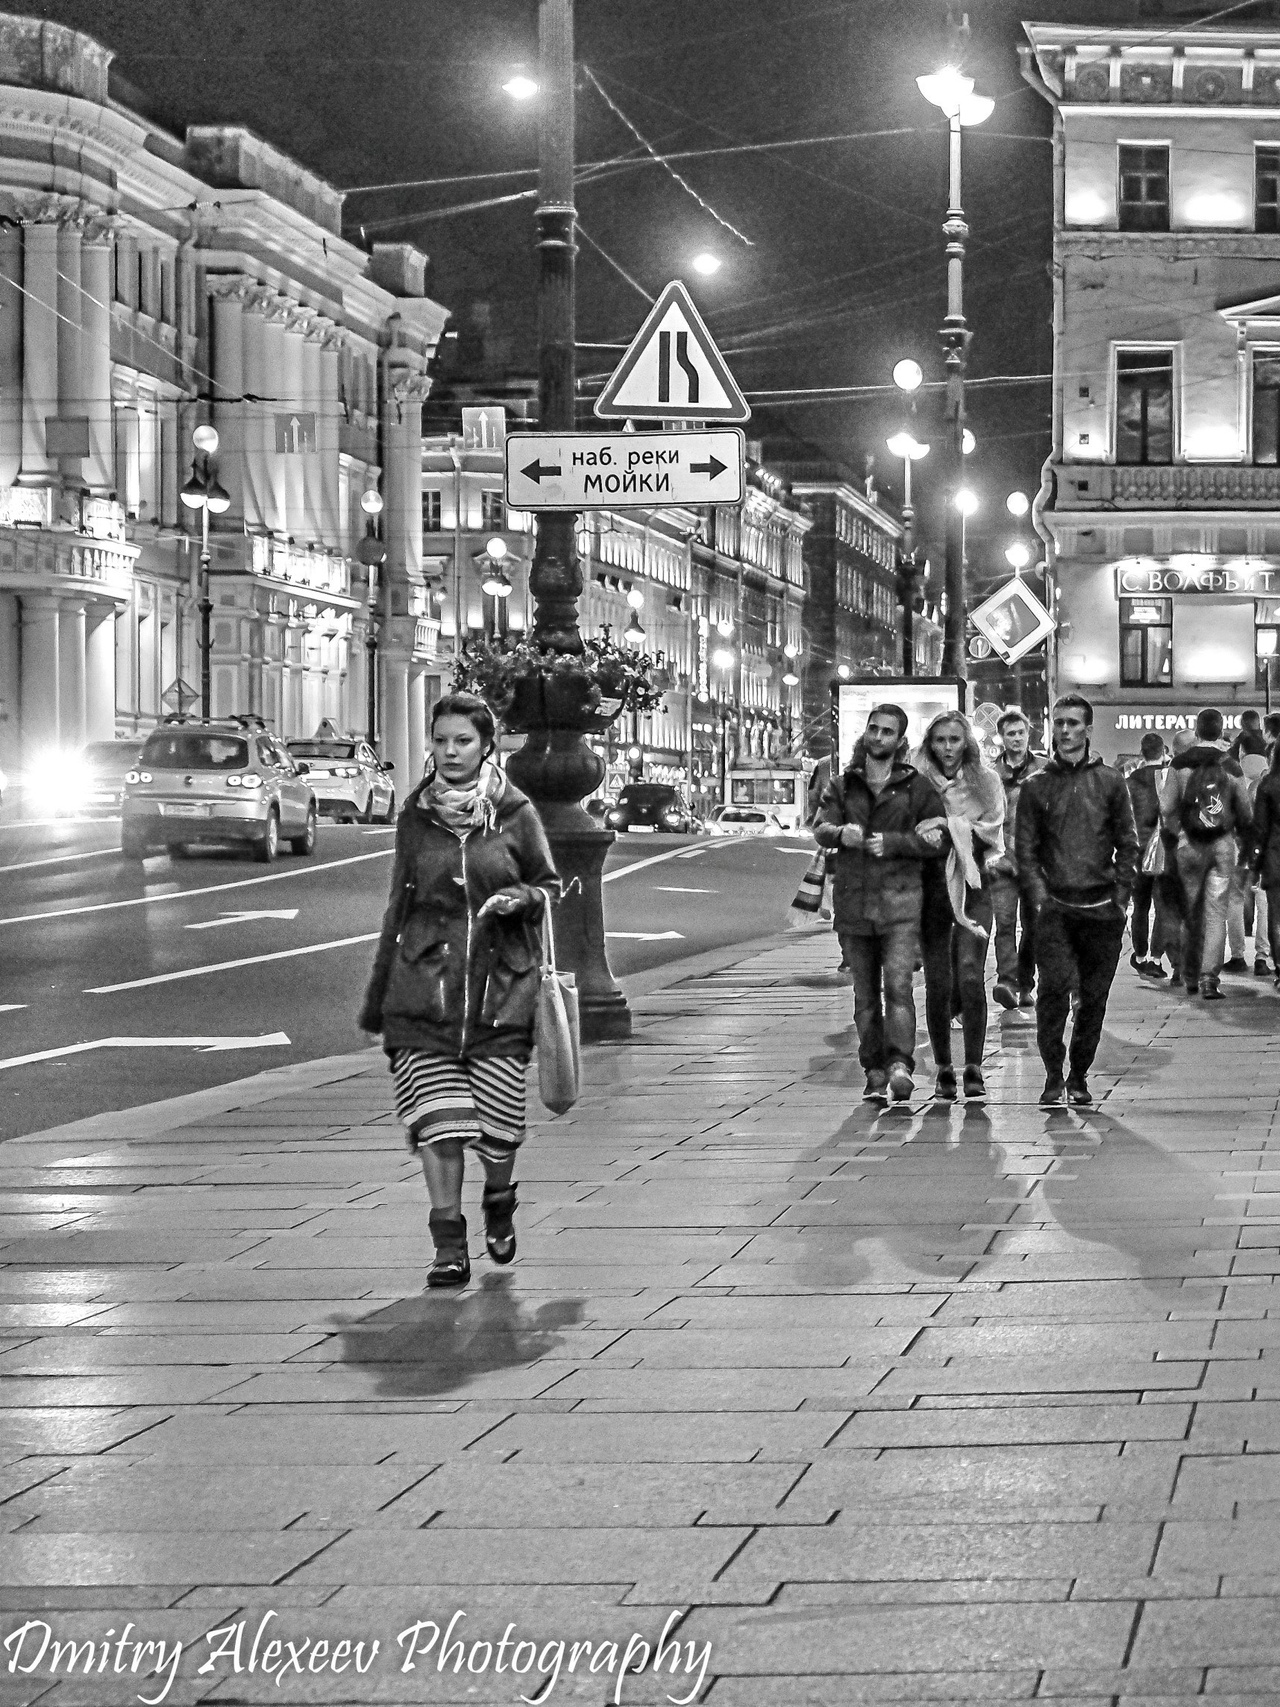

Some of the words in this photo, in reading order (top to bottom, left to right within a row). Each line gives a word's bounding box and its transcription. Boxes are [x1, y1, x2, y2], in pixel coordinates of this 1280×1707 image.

[572, 446, 617, 466] наб.
[628, 449, 679, 470] реки
[583, 469, 670, 493] МОЙКИ
[1121, 571, 1142, 592] С.
[1147, 571, 1240, 592] ВОЛФЪ
